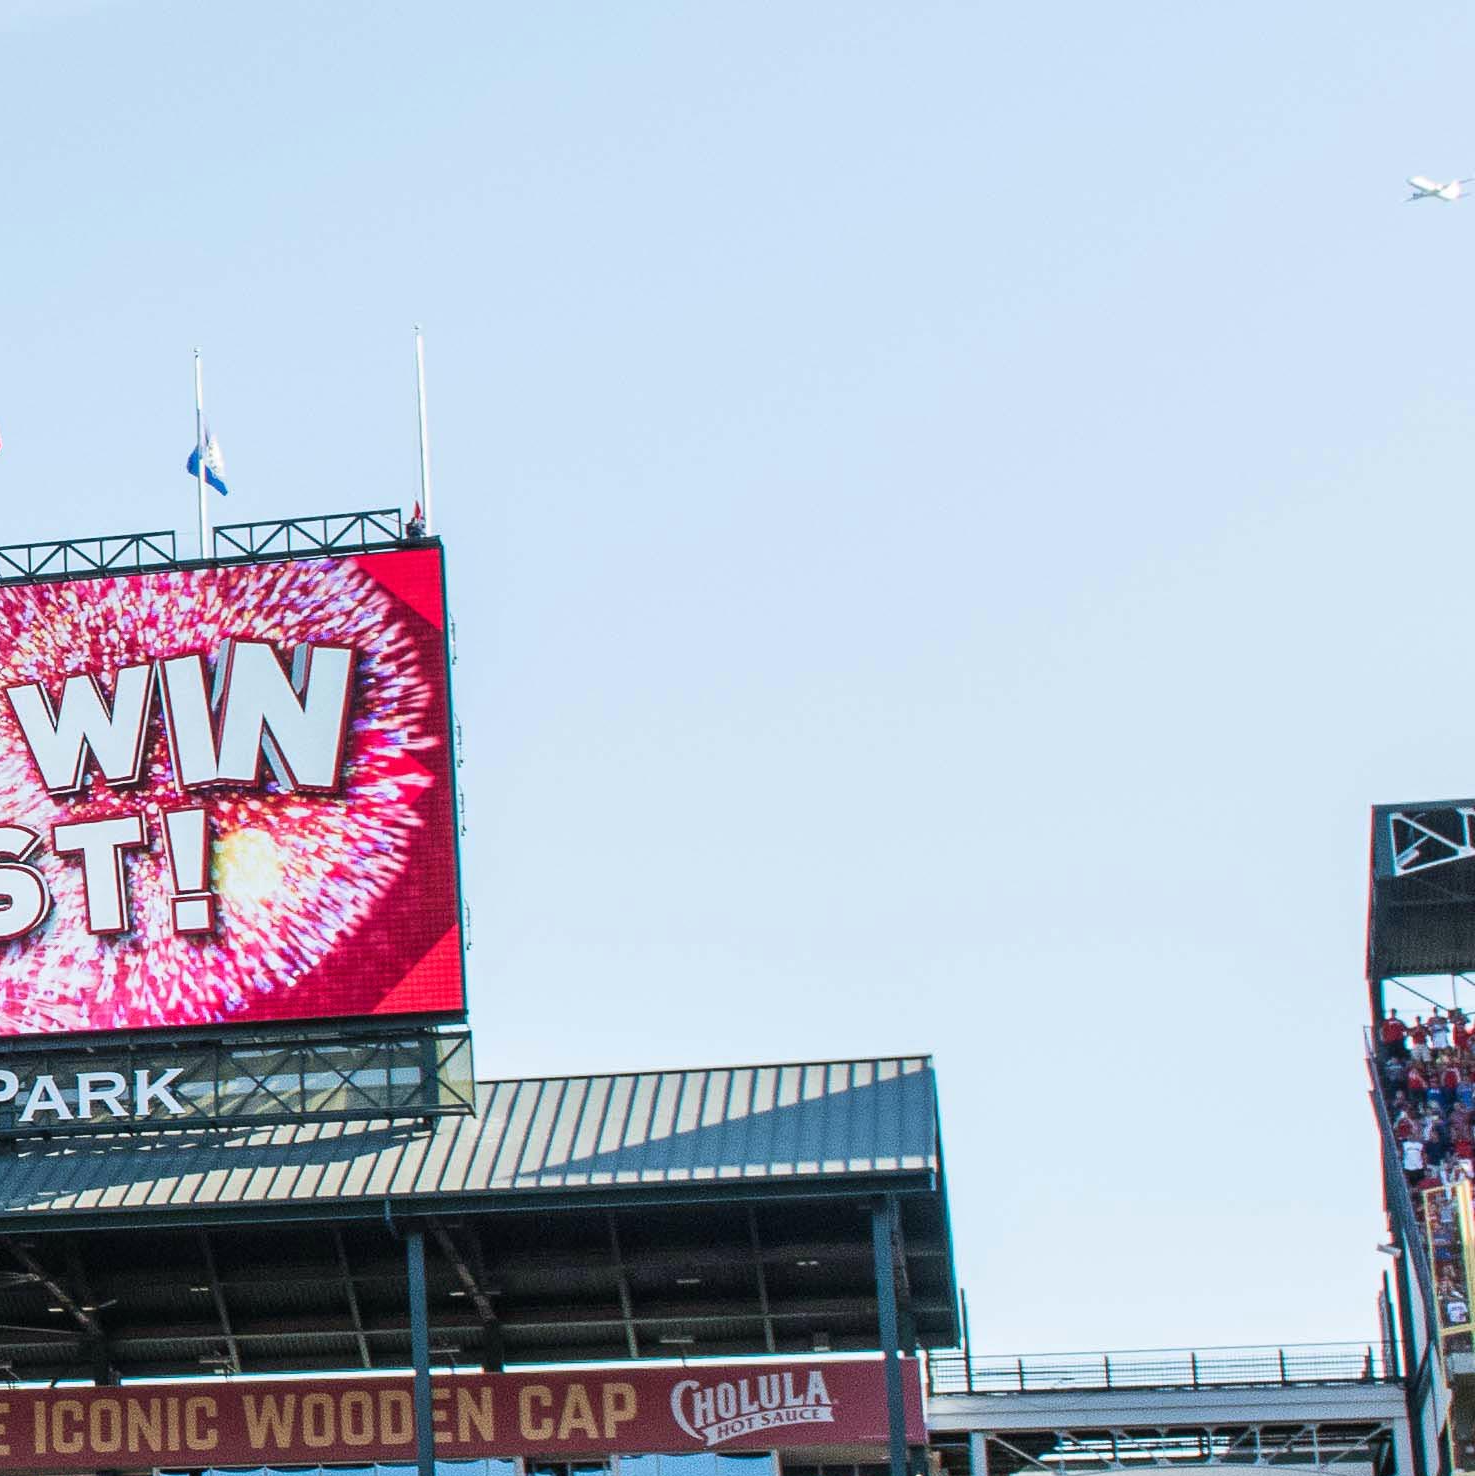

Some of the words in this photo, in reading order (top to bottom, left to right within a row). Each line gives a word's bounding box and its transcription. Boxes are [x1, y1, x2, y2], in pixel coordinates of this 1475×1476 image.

[6, 639, 355, 797] WIN
[34, 1394, 219, 1454] ICONIC
[243, 1385, 494, 1449] WOODEN
[518, 1381, 640, 1442] CAP
[670, 1371, 833, 1440] CHOLULA
[716, 1419, 757, 1439] HOT
[761, 1407, 821, 1427] SAUCE
